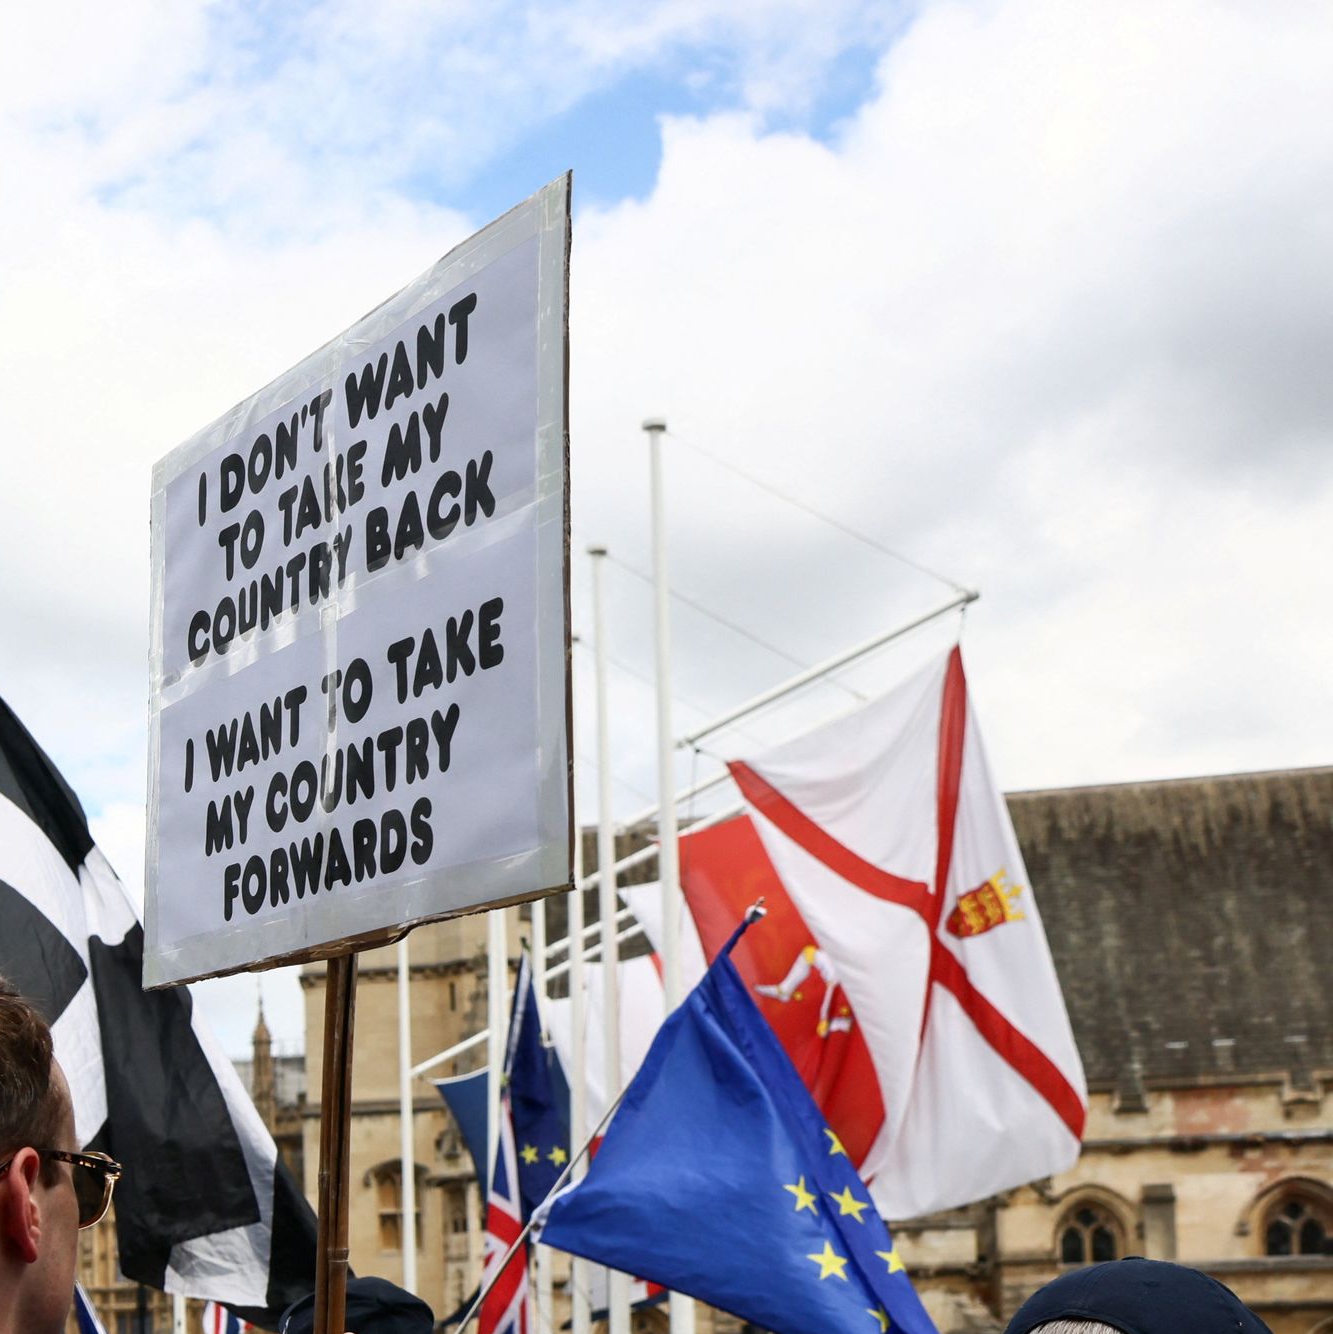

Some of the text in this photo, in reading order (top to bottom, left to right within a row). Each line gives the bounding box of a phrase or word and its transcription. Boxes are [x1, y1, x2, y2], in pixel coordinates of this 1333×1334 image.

[198, 292, 478, 528] I DON'T WANT
[219, 392, 449, 582] TO TAKE MY
[187, 449, 496, 663] COUNTRY BACK
[184, 596, 505, 794] I WANT TO TAKE
[205, 702, 460, 857] MY COUNTRY
[223, 796, 434, 923] FORWARDS
